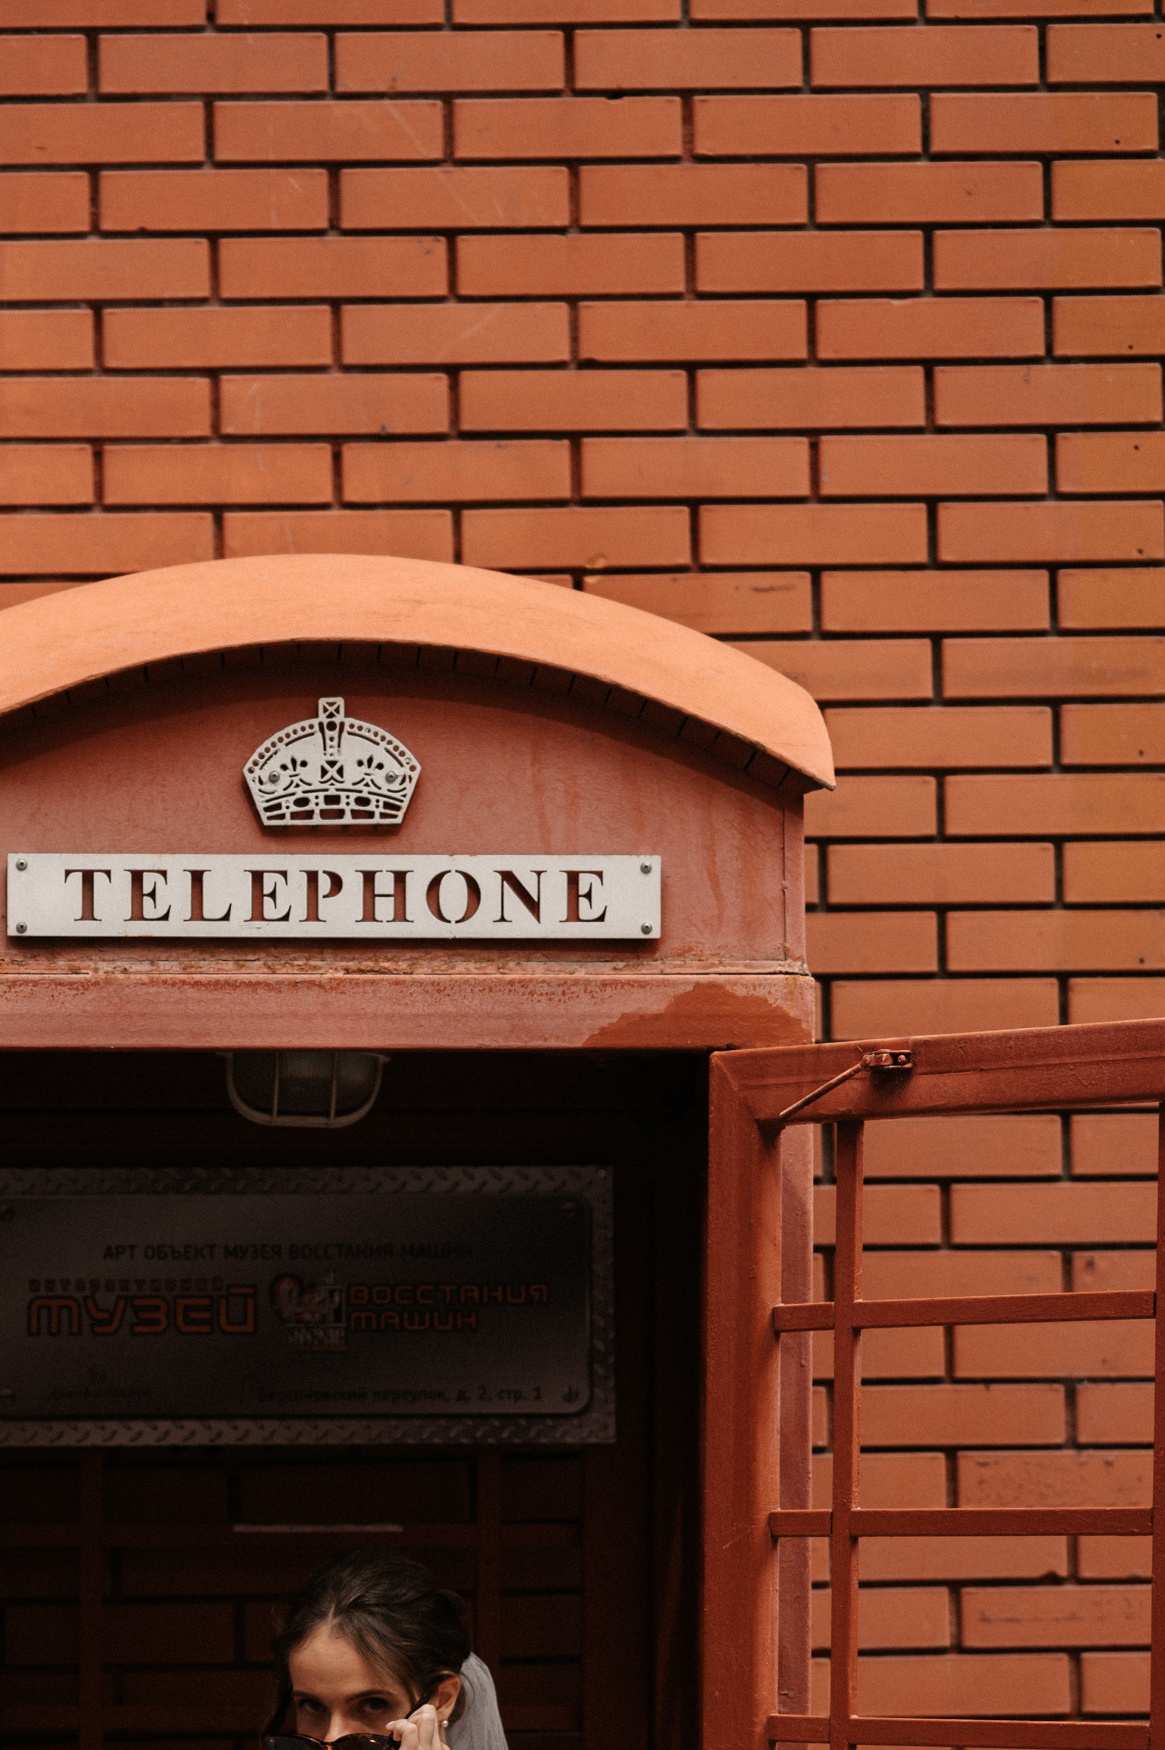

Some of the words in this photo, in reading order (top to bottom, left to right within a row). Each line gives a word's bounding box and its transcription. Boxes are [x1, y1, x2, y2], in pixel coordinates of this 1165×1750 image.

[63, 867, 609, 924] TELEPHONE
[103, 1244, 136, 1260] АРТ
[143, 1244, 216, 1260] ОБЪЕКТ
[223, 1244, 282, 1260] МУЗЕЯ
[288, 1243, 392, 1260] ВОССТАНИЯ
[347, 1283, 549, 1306] ВОССТАНИЯ
[347, 1309, 478, 1333] МАШИН
